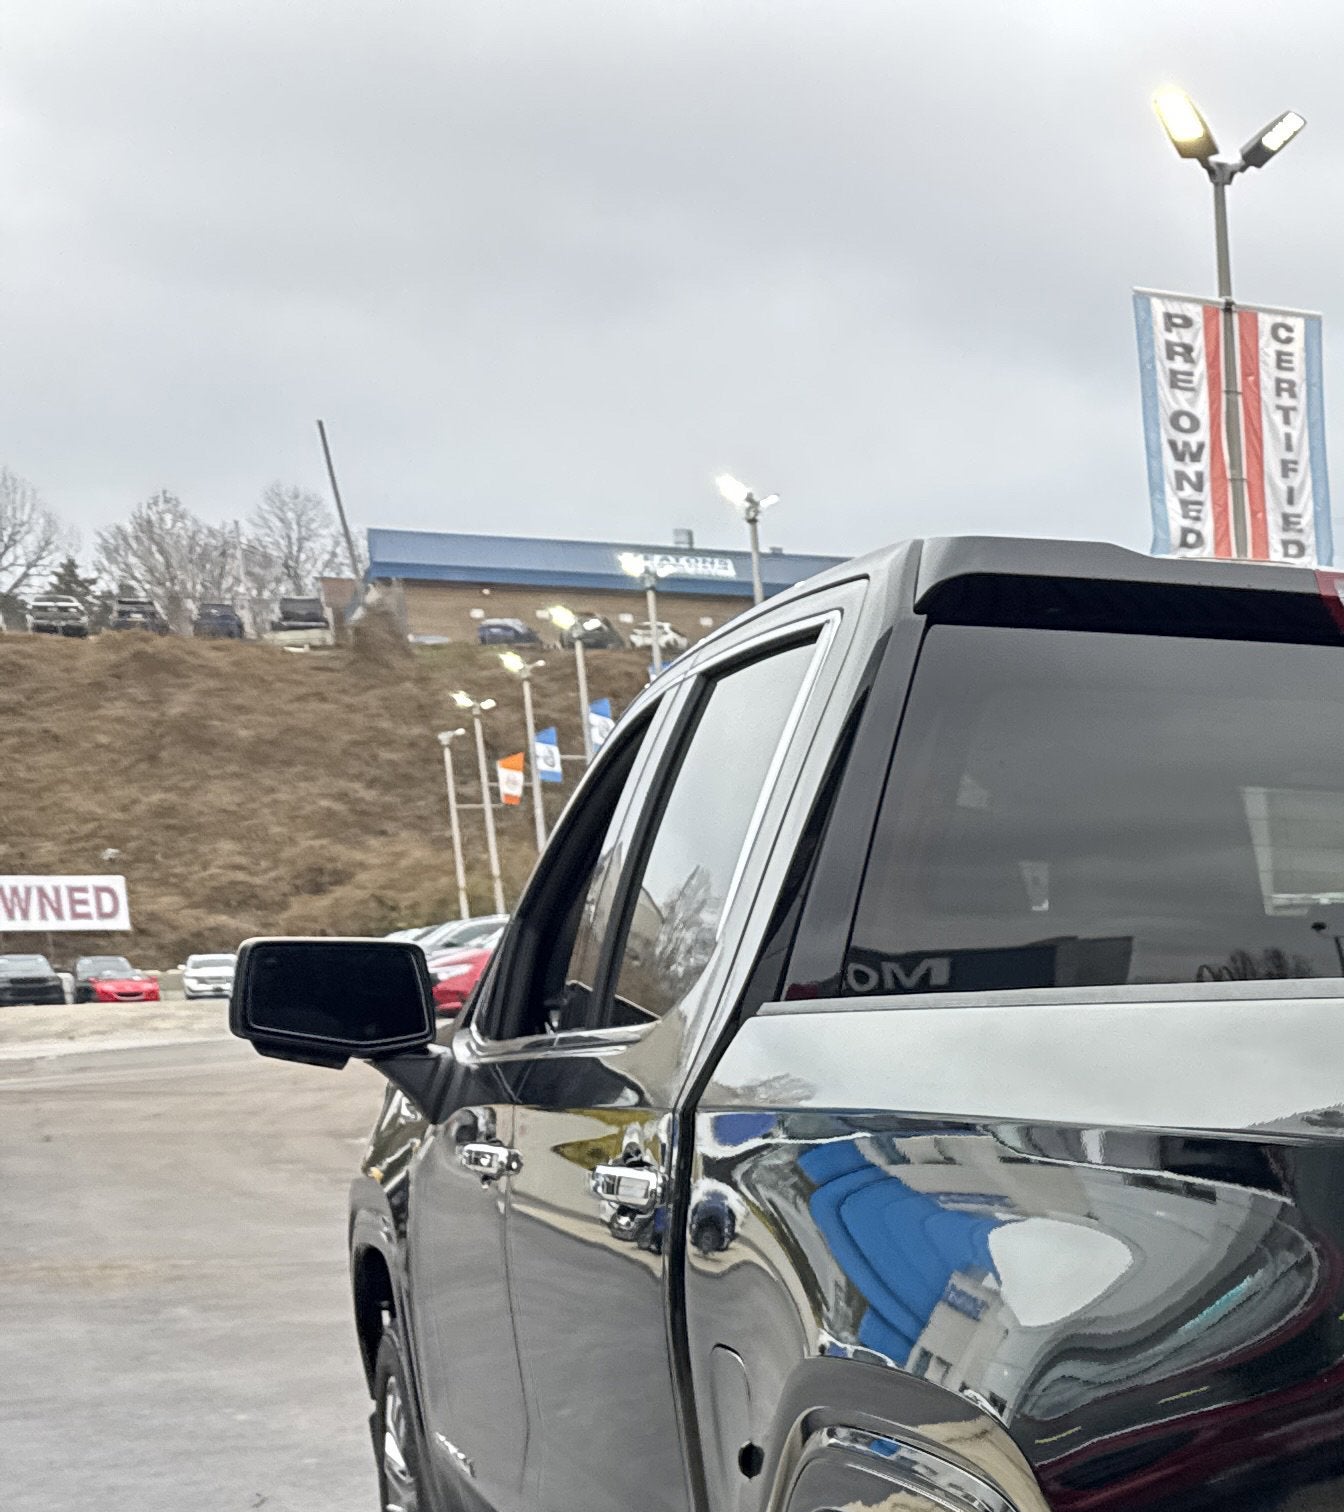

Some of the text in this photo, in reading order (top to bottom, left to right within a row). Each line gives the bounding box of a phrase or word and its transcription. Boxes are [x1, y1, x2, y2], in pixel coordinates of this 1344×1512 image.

[1163, 312, 1205, 551] PRE OWNED
[1271, 322, 1306, 559] CERTIFIED
